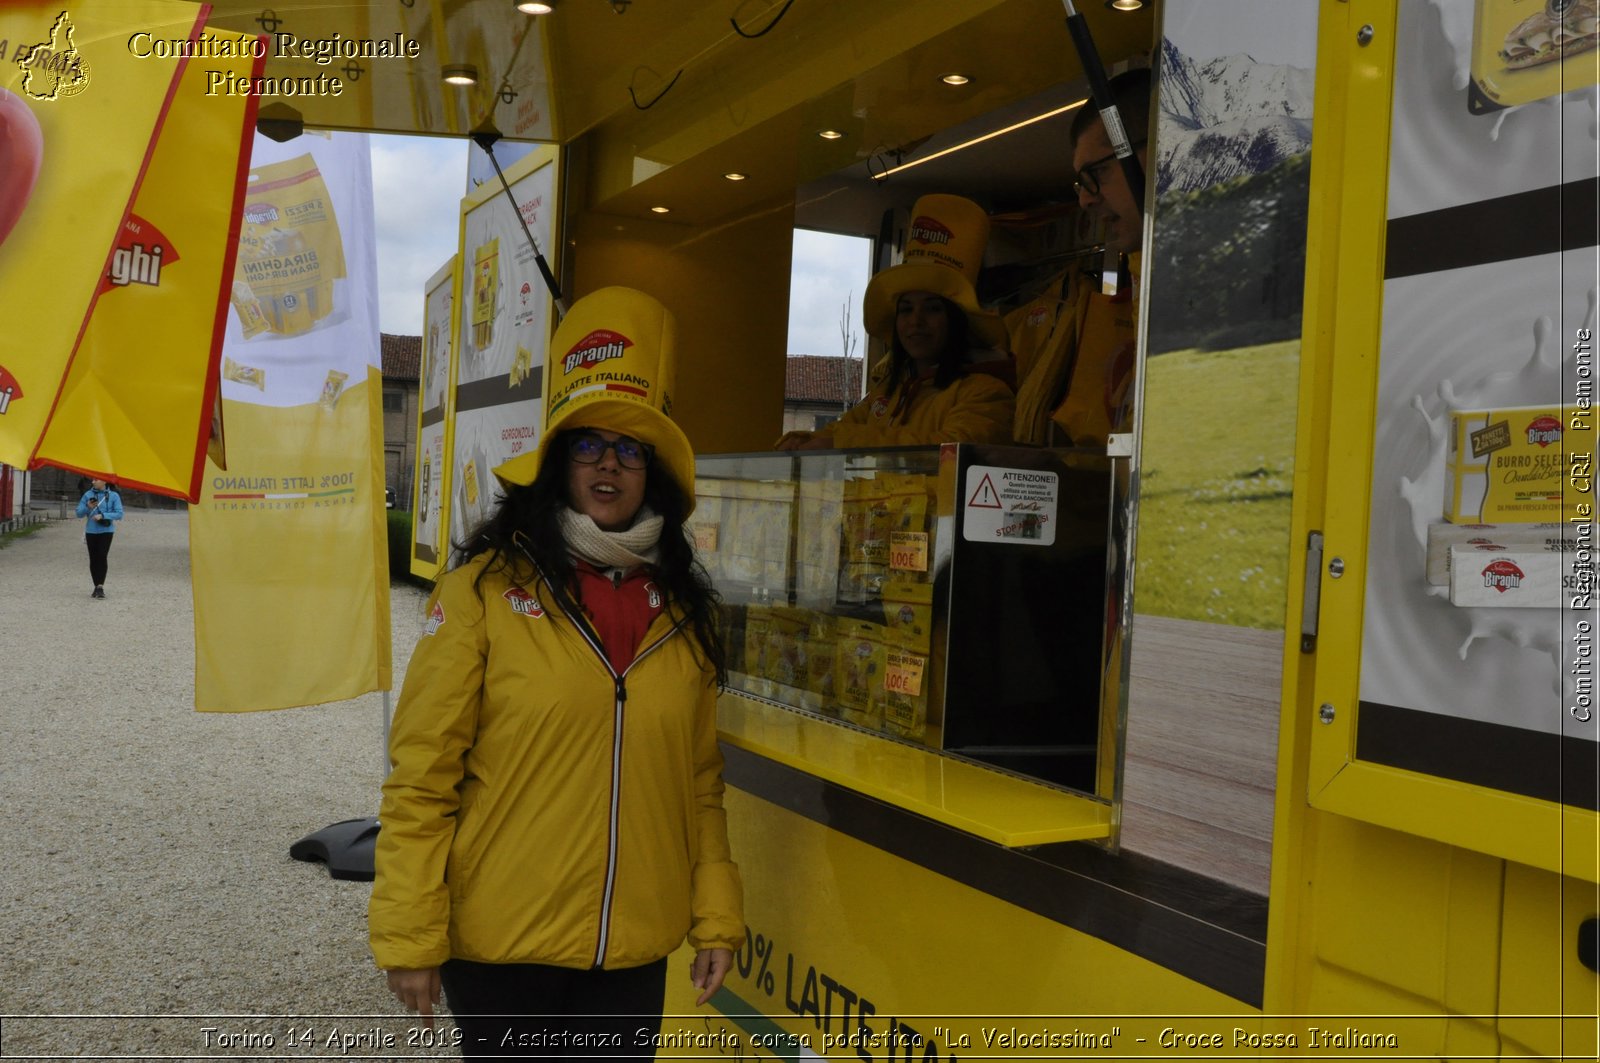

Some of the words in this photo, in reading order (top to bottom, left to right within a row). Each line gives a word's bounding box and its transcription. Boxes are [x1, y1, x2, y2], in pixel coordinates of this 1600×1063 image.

[911, 225, 950, 246] iraghi
[564, 341, 625, 376] Biraghi
[565, 376, 592, 393] LATTE
[595, 372, 650, 389] ITALIANO
[501, 426, 535, 441] GORGONZOLA
[511, 441, 523, 454] DOP
[1473, 436, 1482, 452] 2
[1496, 455, 1532, 469] BURRO
[996, 523, 1017, 537] STOP
[1484, 571, 1521, 590] Biraghi
[511, 594, 542, 613] Bira
[649, 590, 661, 607] Bi
[737, 925, 775, 997] 0%
[785, 953, 876, 1063] LATTE
